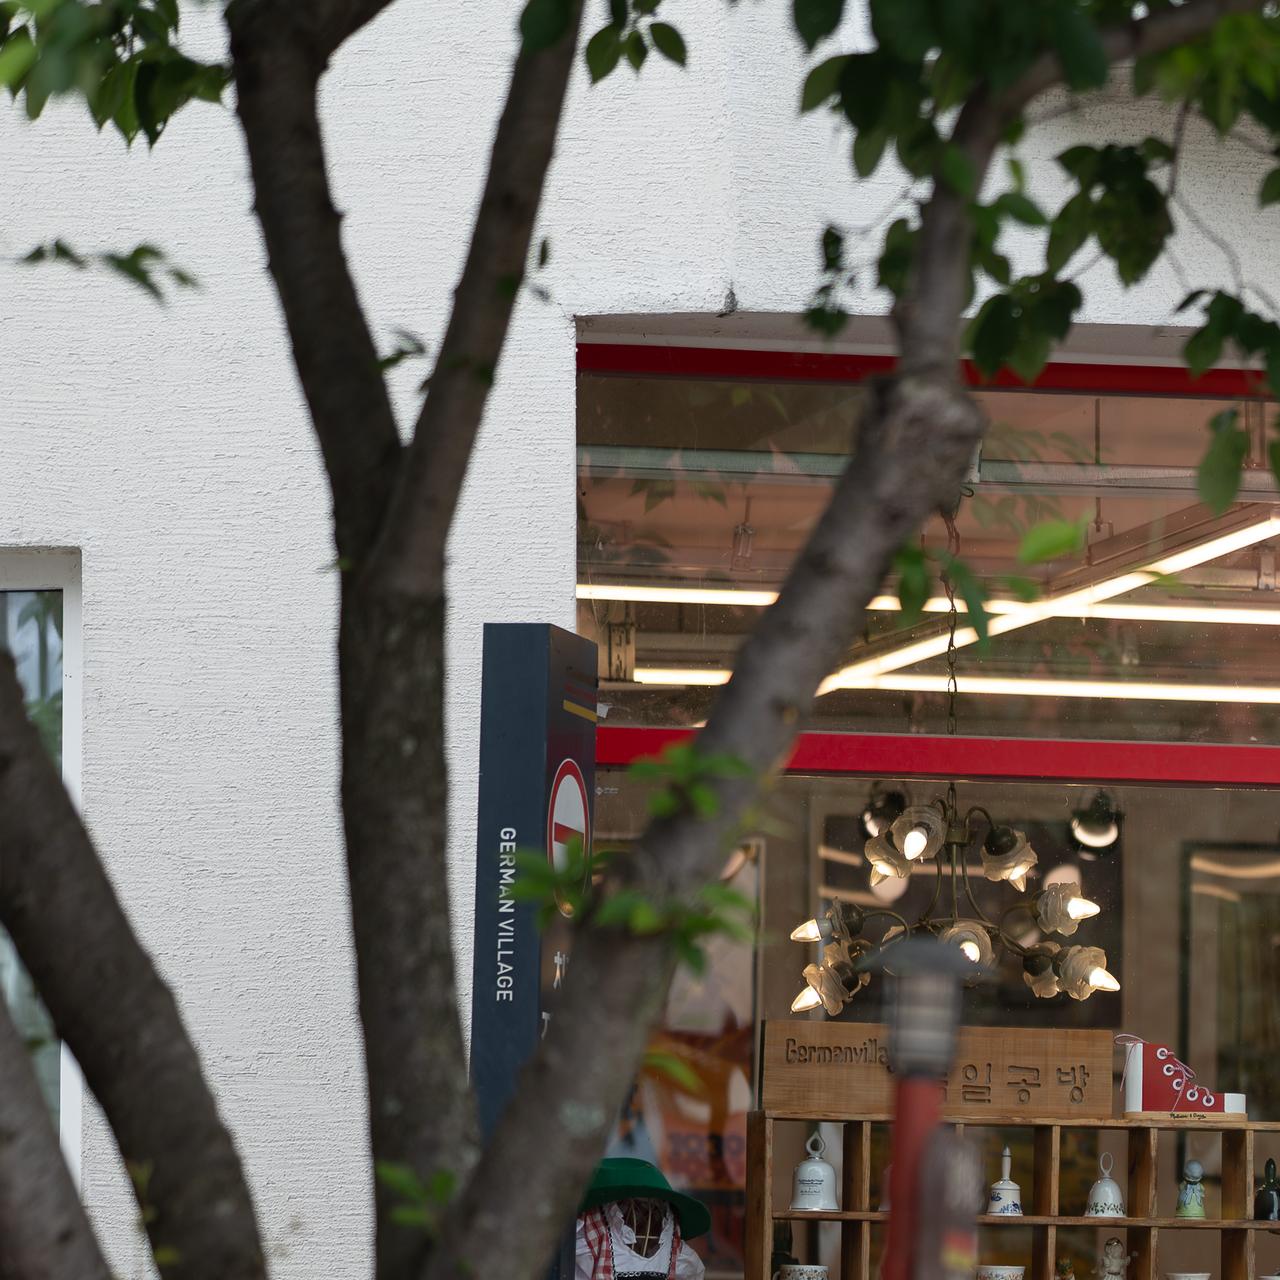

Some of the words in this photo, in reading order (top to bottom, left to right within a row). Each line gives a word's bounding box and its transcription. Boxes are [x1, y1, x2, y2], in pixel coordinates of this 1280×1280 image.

[498, 827, 517, 913] GERMAN
[496, 918, 515, 1002] VILLAGE
[785, 1038, 897, 1074] Germanvilla
